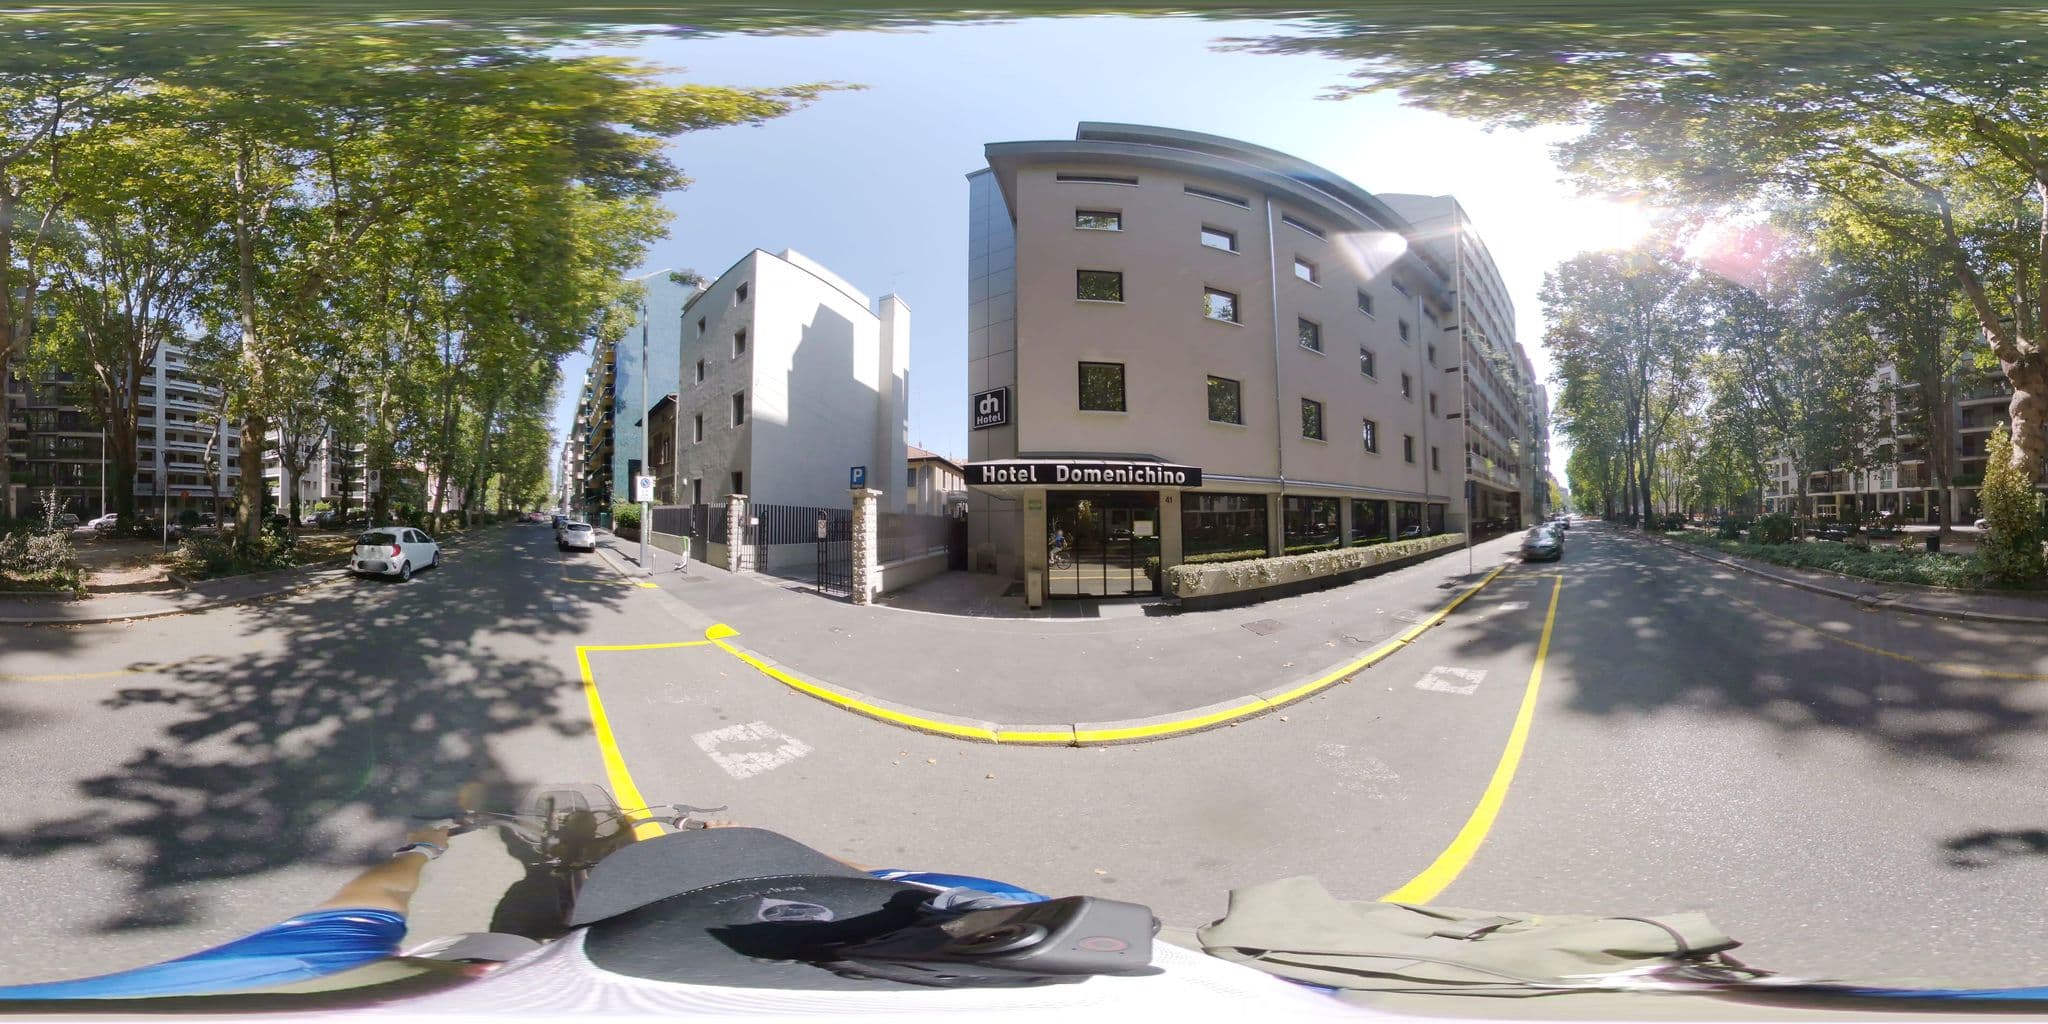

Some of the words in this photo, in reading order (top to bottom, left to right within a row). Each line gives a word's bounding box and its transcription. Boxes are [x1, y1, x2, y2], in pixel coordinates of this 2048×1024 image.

[979, 393, 999, 415] dh
[976, 412, 1002, 425] Hotel
[853, 468, 863, 483] P
[982, 465, 1037, 483] Hotel
[1056, 465, 1186, 484] Domenichino
[1164, 496, 1173, 504] 41
